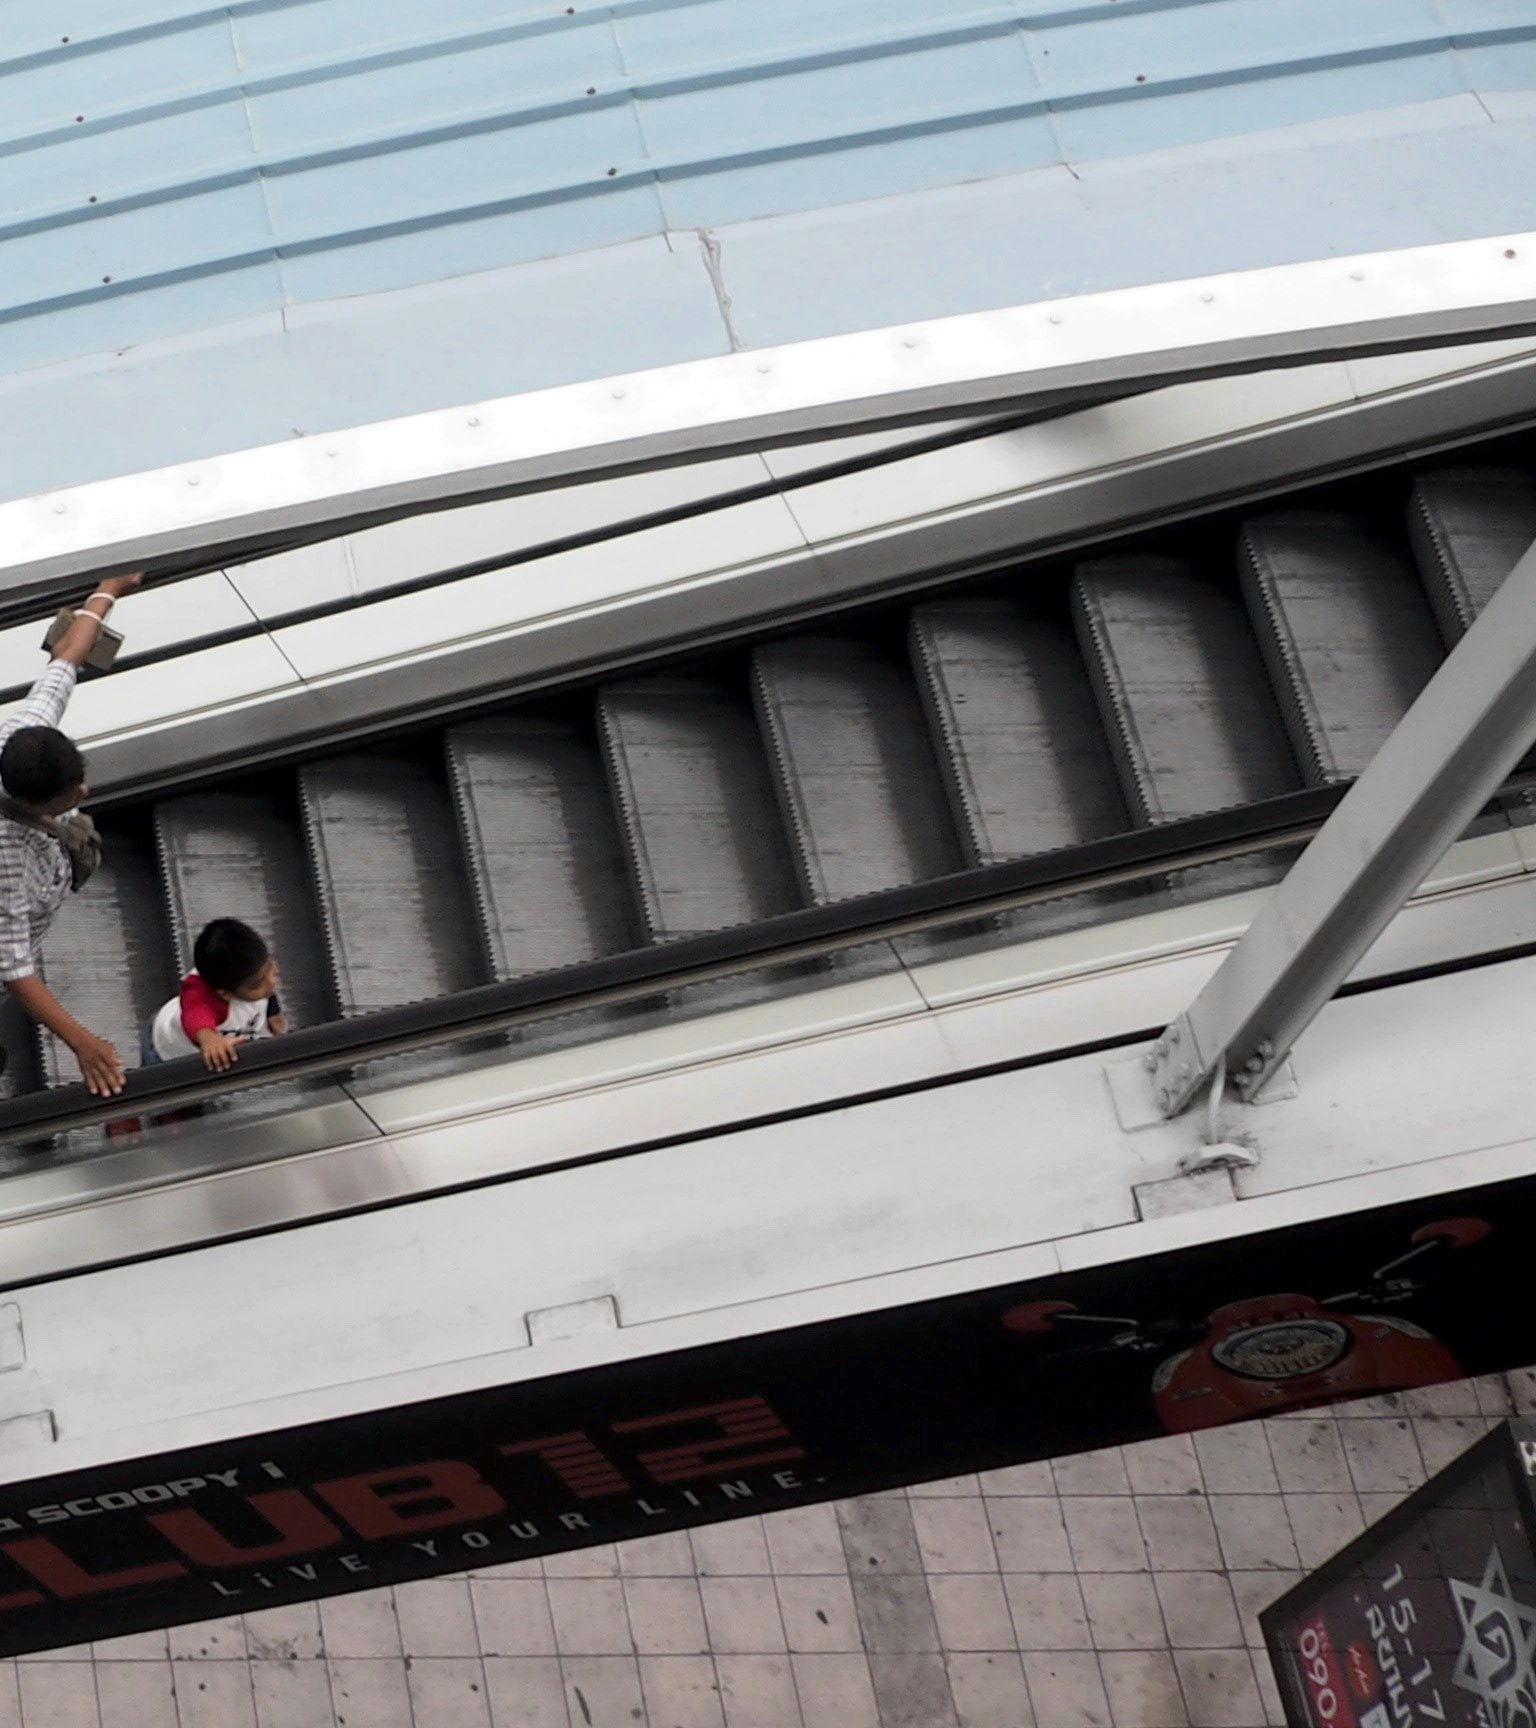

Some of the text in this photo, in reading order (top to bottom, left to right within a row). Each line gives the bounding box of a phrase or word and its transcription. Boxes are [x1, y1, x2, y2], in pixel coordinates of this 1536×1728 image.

[26, 1467, 240, 1525] SCOOPY
[412, 1510, 591, 1559] YOUR
[636, 1468, 825, 1517] LINE.
[1381, 1562, 1447, 1722] 15-17
